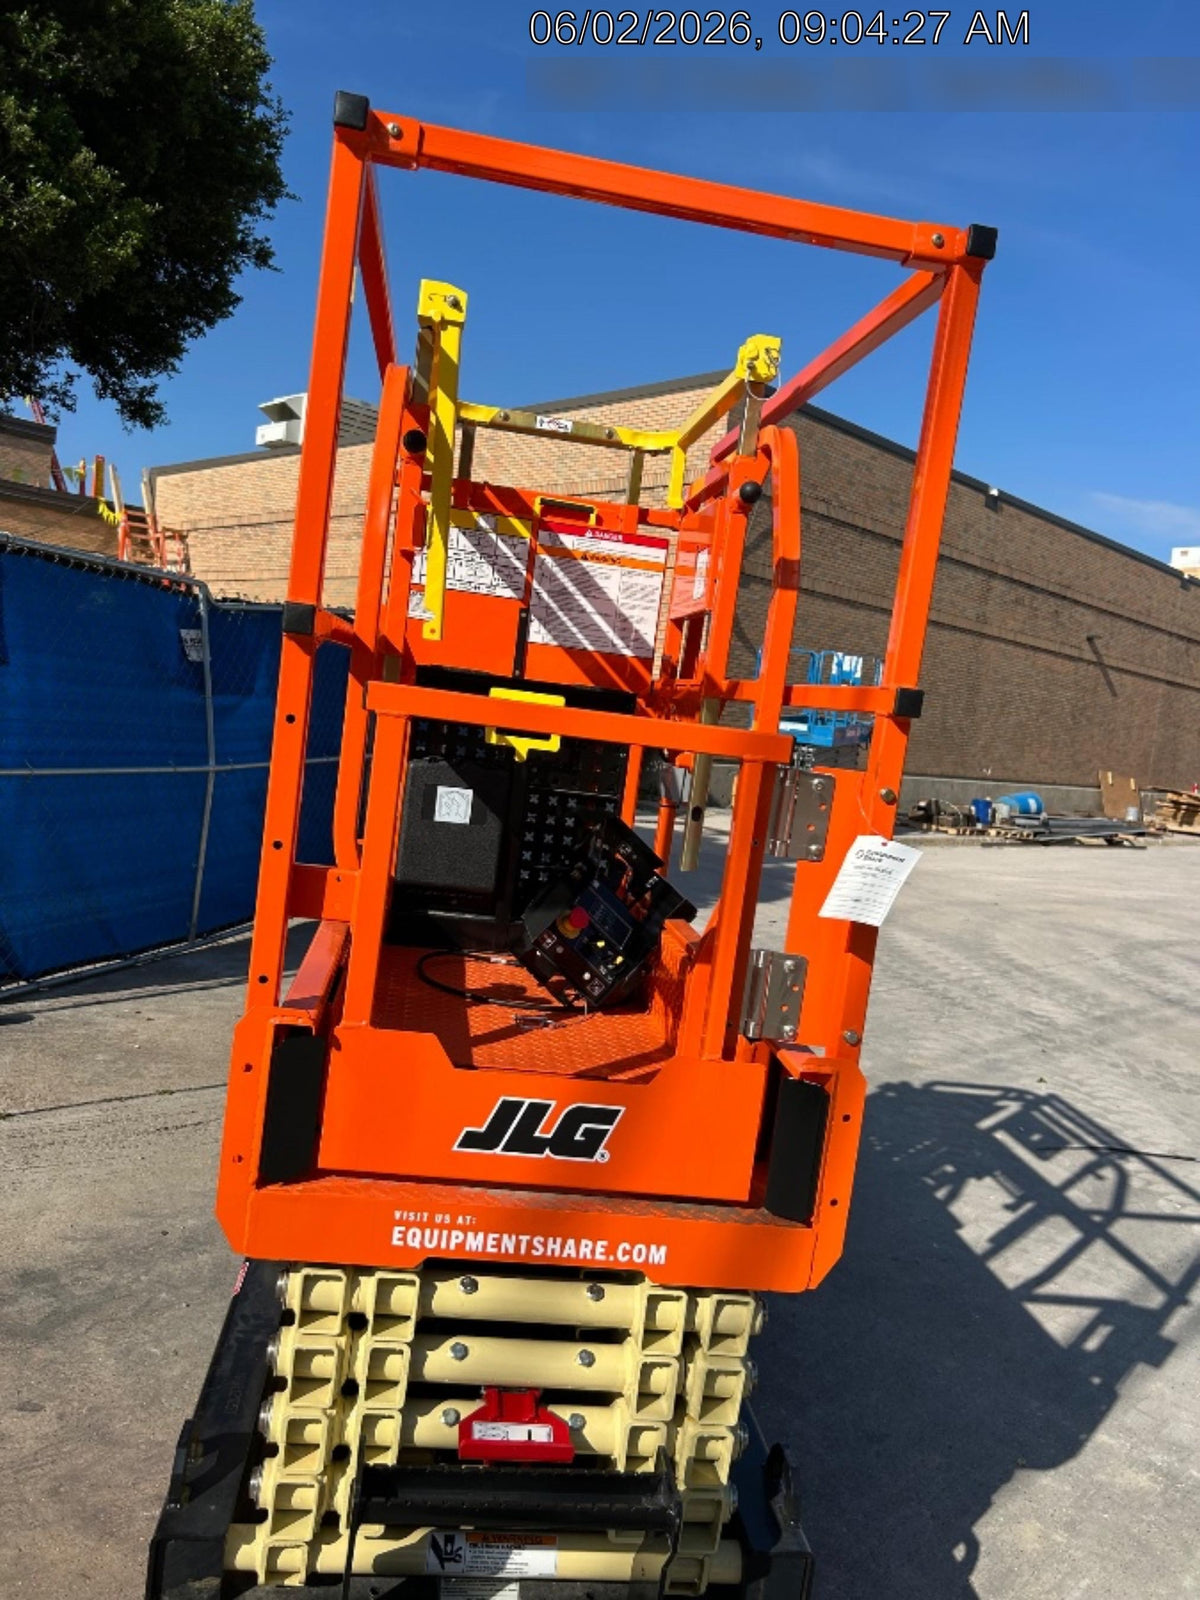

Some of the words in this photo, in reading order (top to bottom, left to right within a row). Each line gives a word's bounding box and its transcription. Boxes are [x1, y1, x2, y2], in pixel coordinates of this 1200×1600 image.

[452, 1096, 626, 1162] JLG
[394, 1210, 428, 1223] VISIT
[434, 1213, 451, 1224] US
[456, 1215, 477, 1226] AT:
[391, 1226, 667, 1264] EQUIPMENTSHARE.COM
